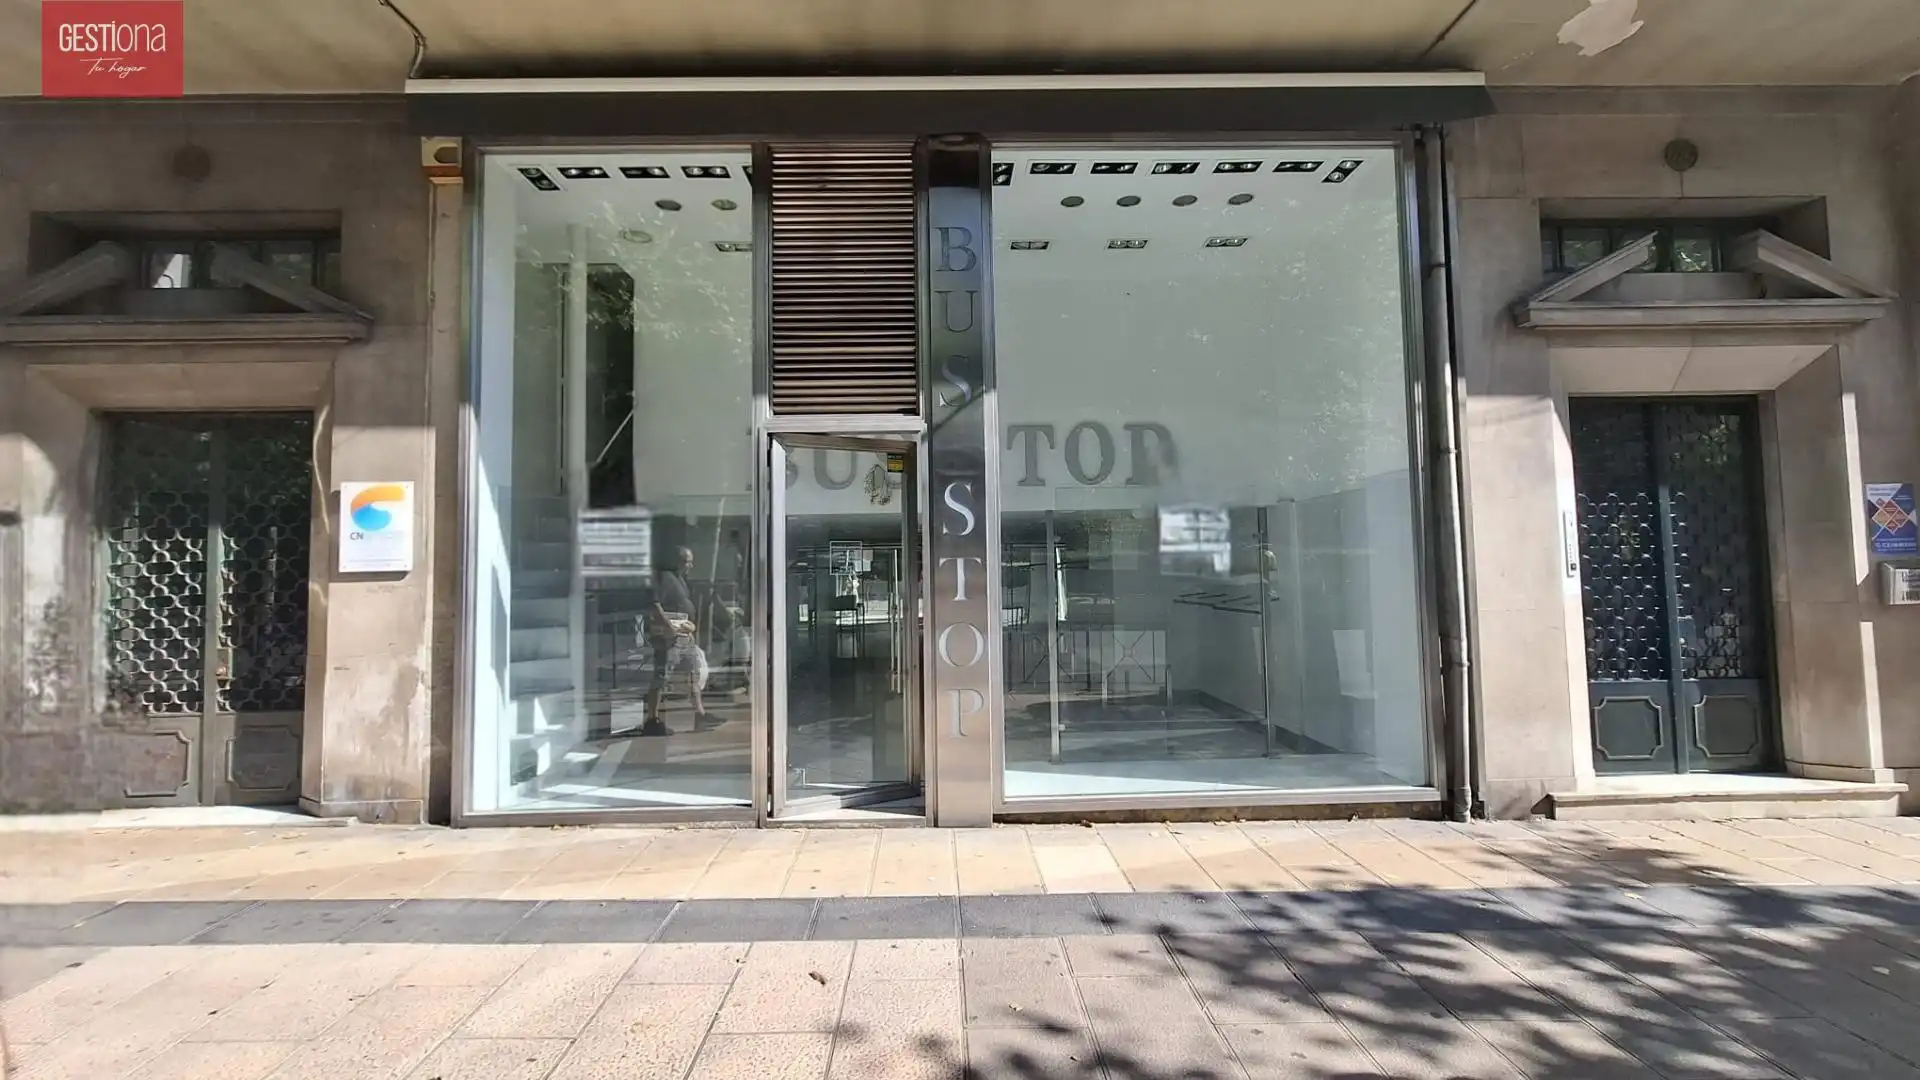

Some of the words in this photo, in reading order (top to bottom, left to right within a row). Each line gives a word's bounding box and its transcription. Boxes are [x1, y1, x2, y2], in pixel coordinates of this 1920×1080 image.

[934, 226, 978, 407] BUS
[1006, 420, 1177, 487] TOP
[938, 482, 985, 738] STOP
